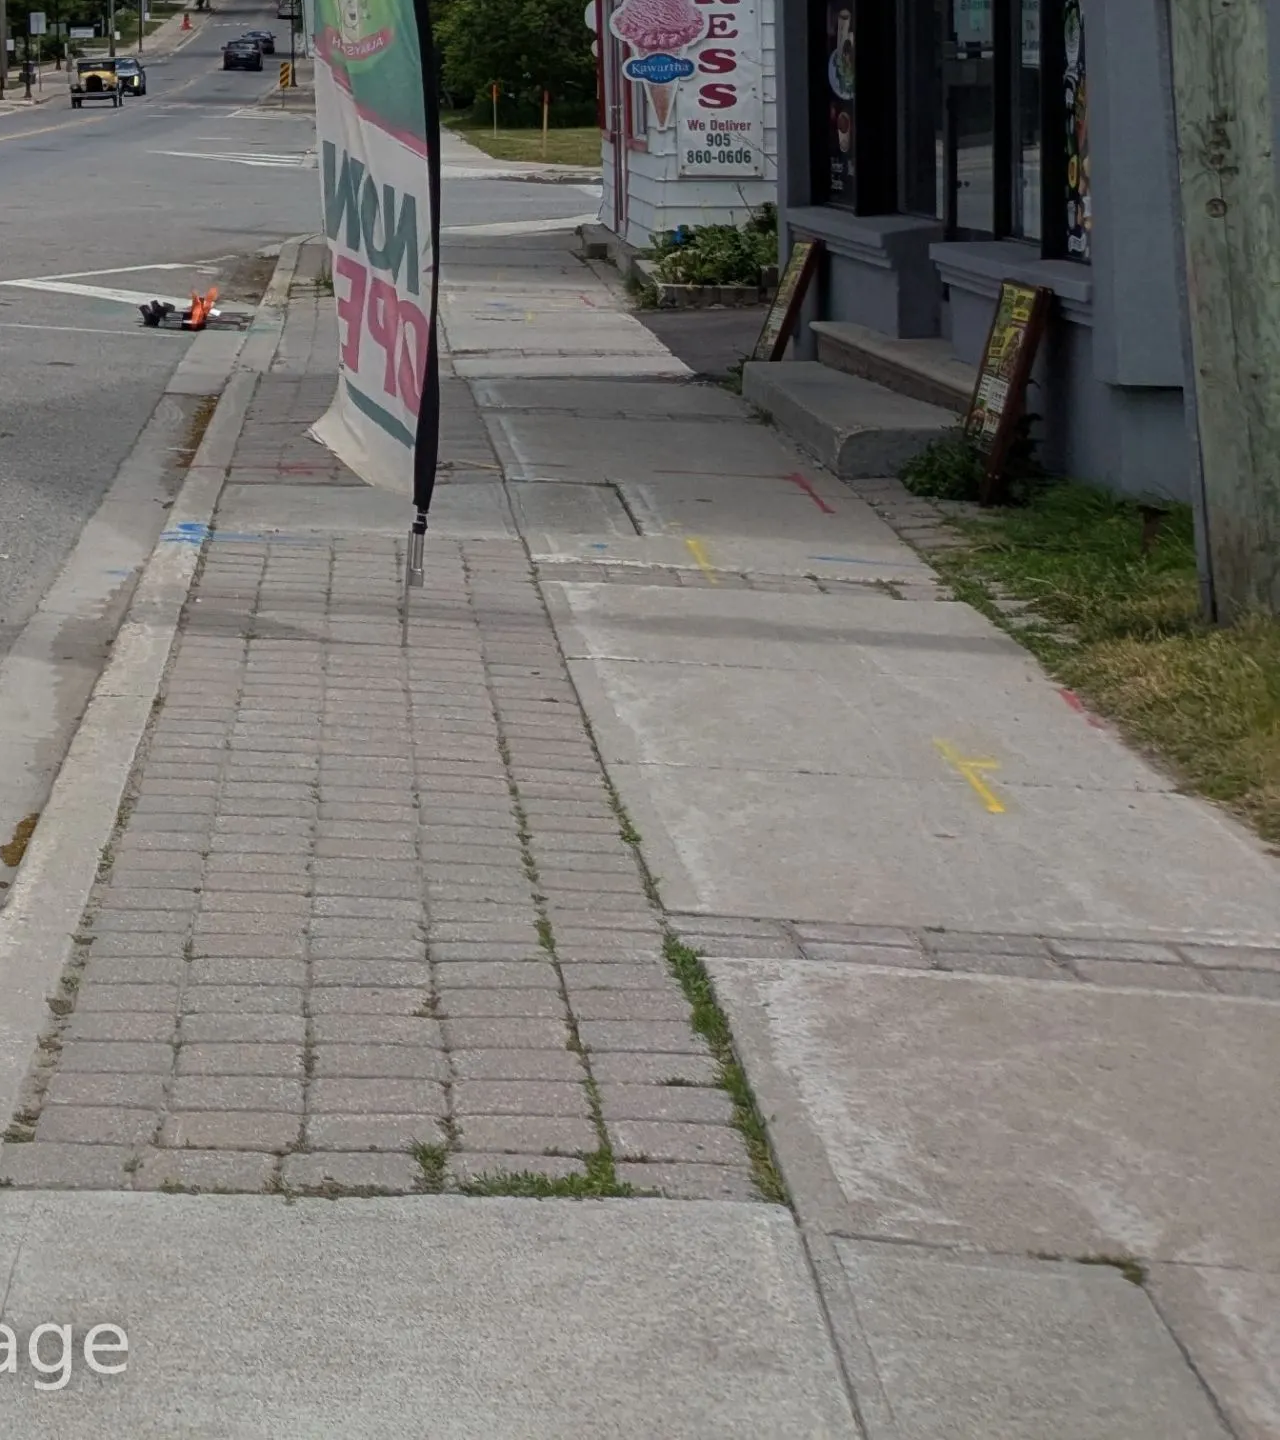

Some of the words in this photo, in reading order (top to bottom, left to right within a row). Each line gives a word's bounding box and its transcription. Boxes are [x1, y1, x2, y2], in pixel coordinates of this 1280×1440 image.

[632, 60, 690, 75] Kawartha
[687, 119, 705, 131] We
[710, 119, 751, 131] Deliver
[706, 133, 731, 147] 905
[687, 150, 751, 164] 860-0606
